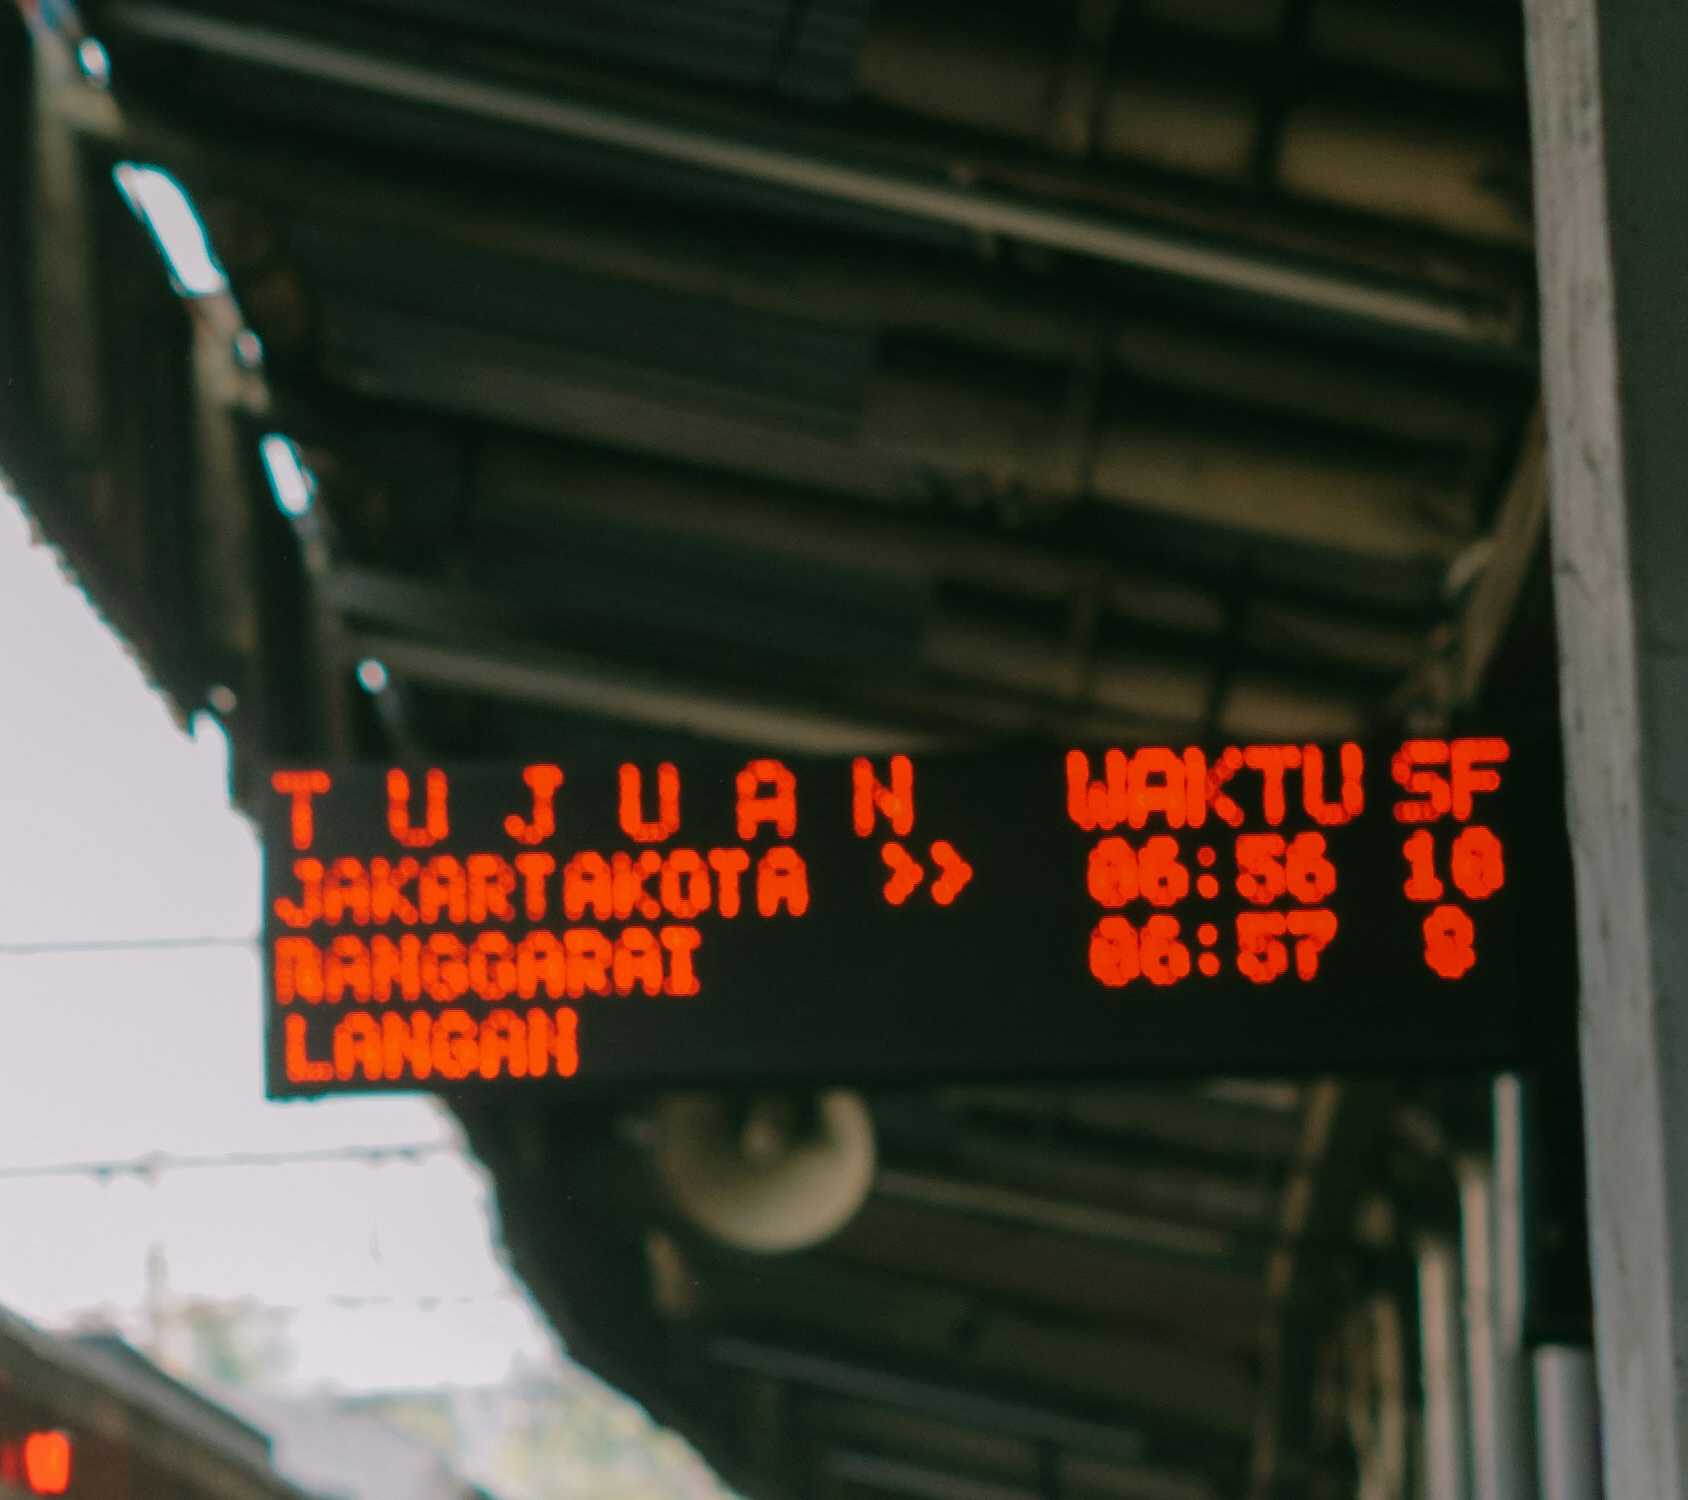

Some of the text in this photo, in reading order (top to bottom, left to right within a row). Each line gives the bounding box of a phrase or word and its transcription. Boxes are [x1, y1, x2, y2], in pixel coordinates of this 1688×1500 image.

[1065, 741, 1365, 831] WAKTU
[1391, 737, 1510, 823] SF
[1086, 831, 1337, 909] 06:56
[1402, 825, 1505, 902] 10
[1088, 908, 1339, 988] 06:57
[284, 1005, 580, 1084] LANGAN
